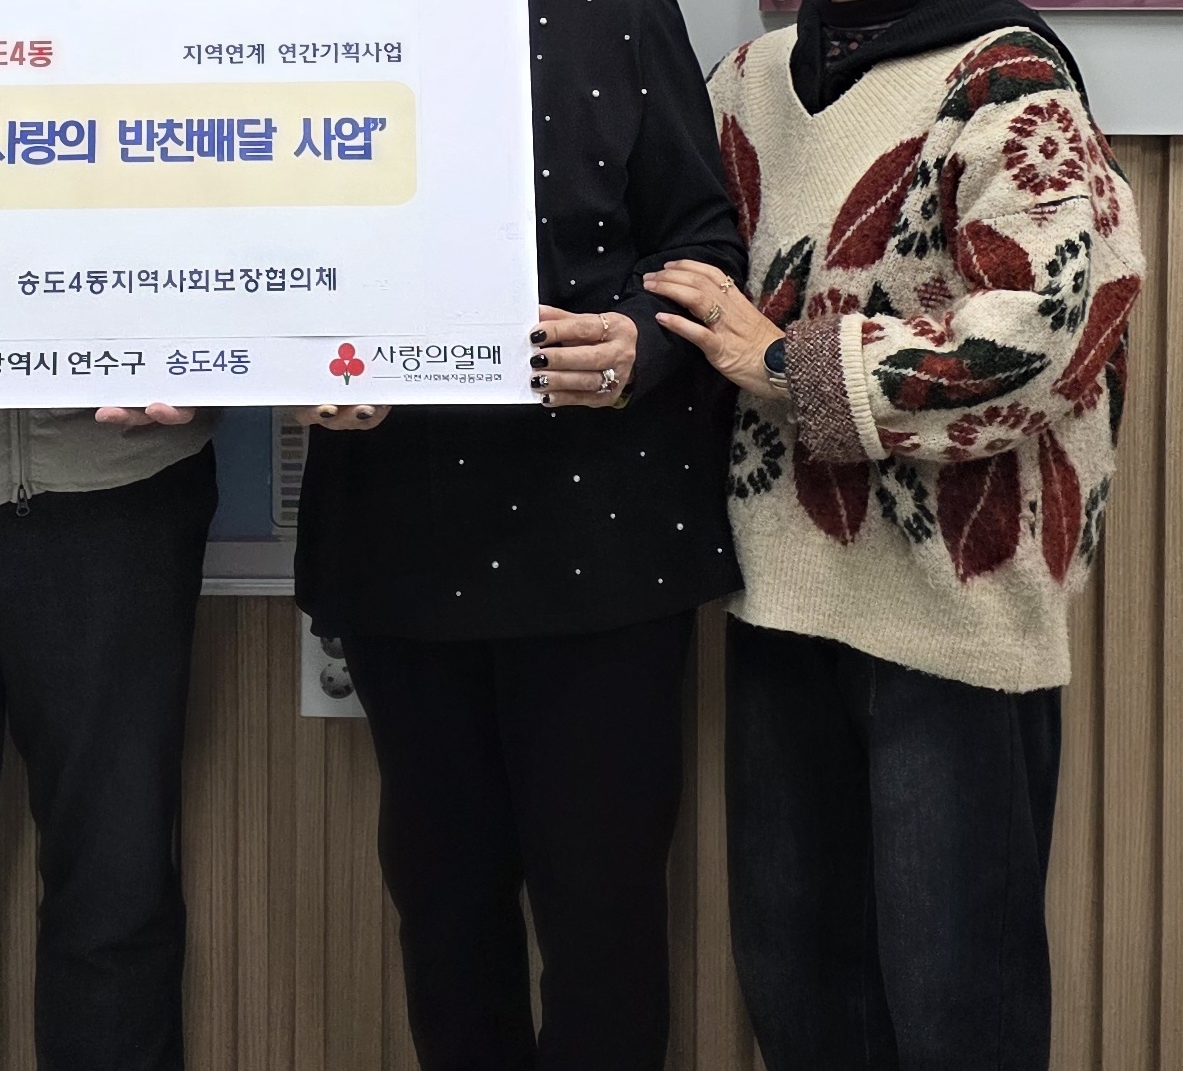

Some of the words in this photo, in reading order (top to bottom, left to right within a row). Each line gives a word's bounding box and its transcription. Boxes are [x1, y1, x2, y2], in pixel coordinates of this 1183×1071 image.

[183, 43, 265, 65] 지역연계
[278, 42, 403, 64] 연간기획사업
[118, 117, 278, 163] 반찬배달
[17, 266, 337, 295] 송도4동지역사회보장협의체
[67, 350, 146, 376] 연수구
[165, 349, 251, 375] 송도4동
[371, 344, 502, 371] 사랑의열매
